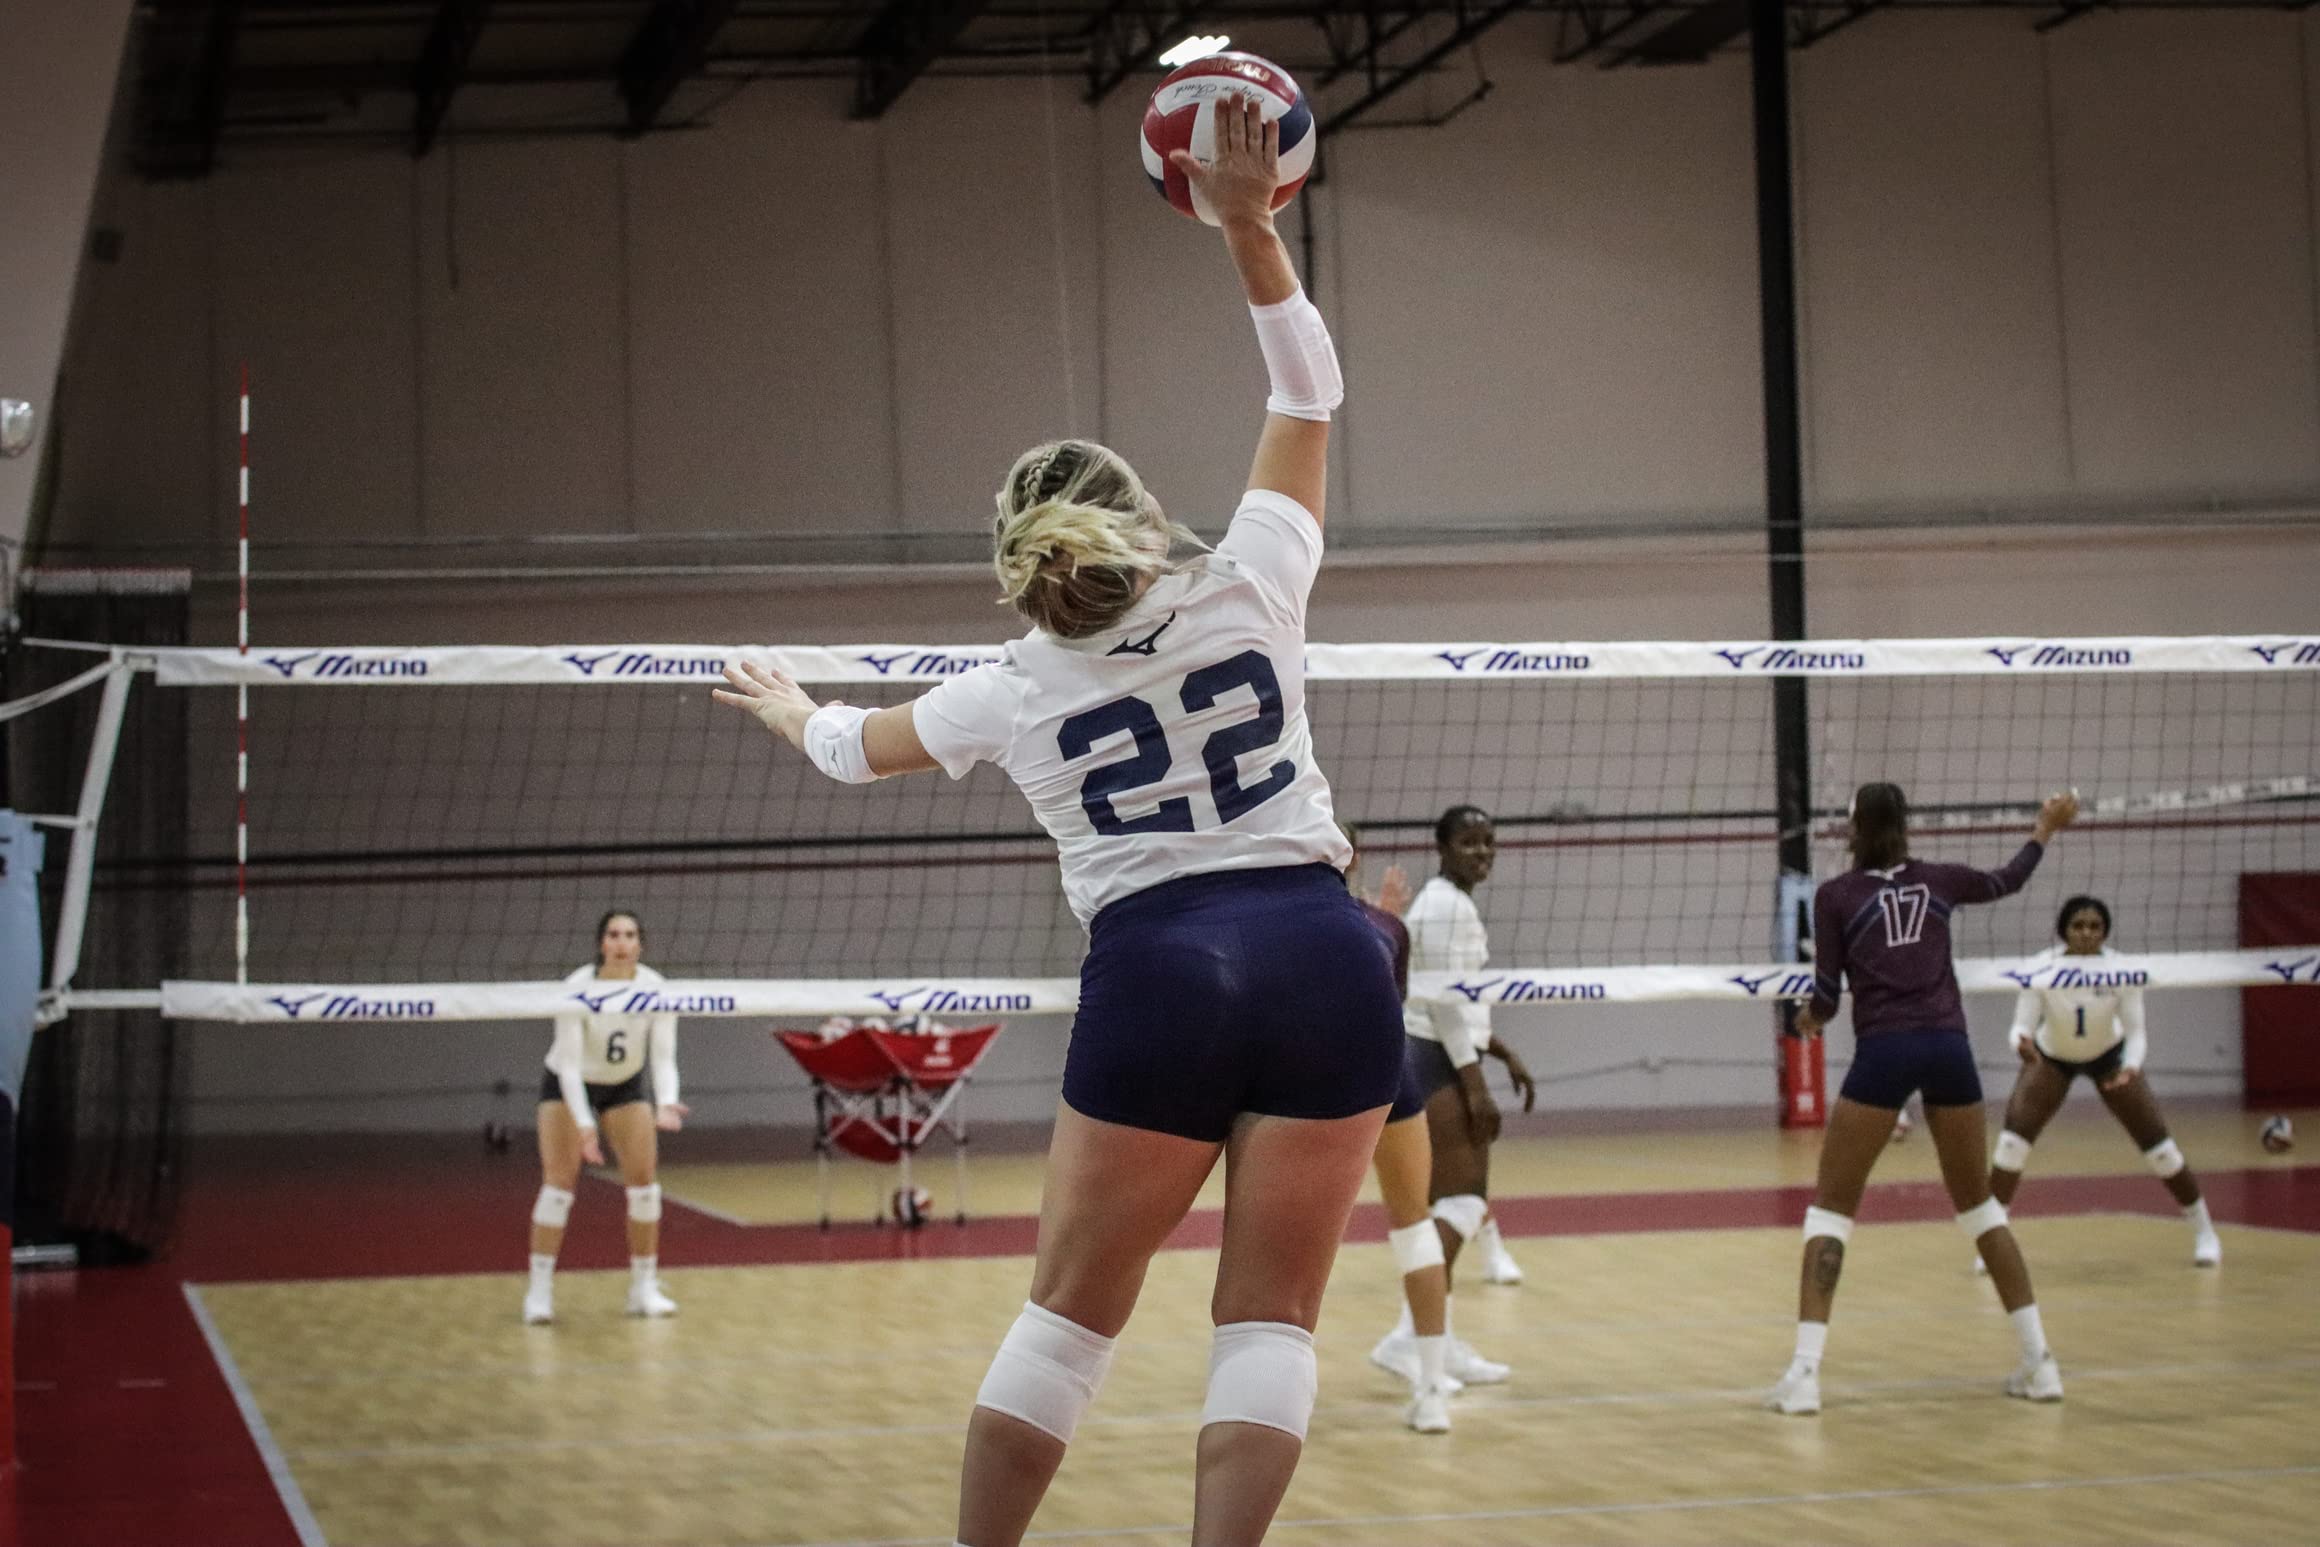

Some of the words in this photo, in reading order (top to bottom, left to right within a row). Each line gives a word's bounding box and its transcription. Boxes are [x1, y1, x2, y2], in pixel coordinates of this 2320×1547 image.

[1057, 649, 1296, 835] 22
[1879, 883, 1931, 948] 17
[2075, 1007, 2086, 1037] 1
[606, 1031, 627, 1063] 6
